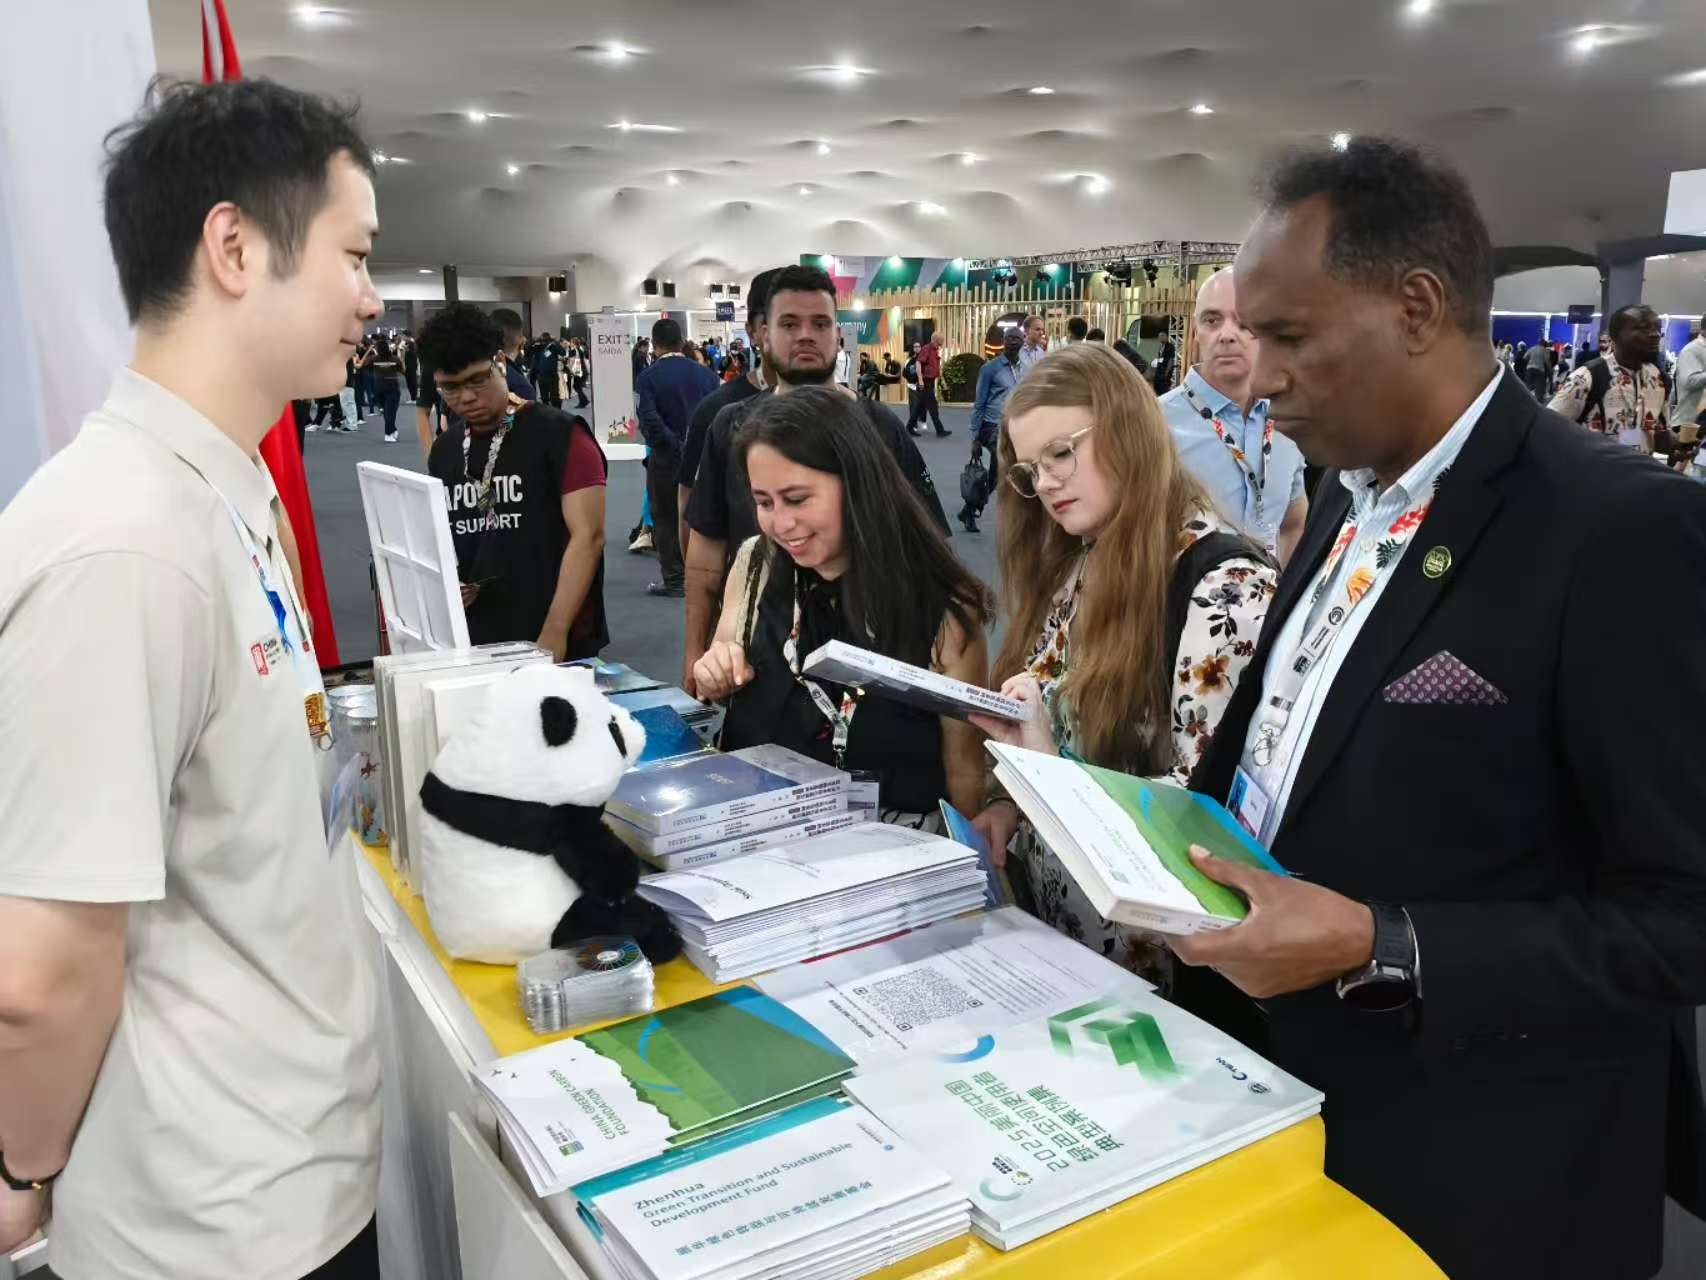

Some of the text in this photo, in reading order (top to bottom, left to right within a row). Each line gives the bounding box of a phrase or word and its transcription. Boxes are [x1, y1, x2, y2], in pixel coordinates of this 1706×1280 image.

[598, 334, 622, 345] EXIT
[634, 1182, 704, 1210] Zhenhua
[643, 1142, 853, 1218] Green Transition and Sustainable
[651, 1179, 779, 1227] Development Fund
